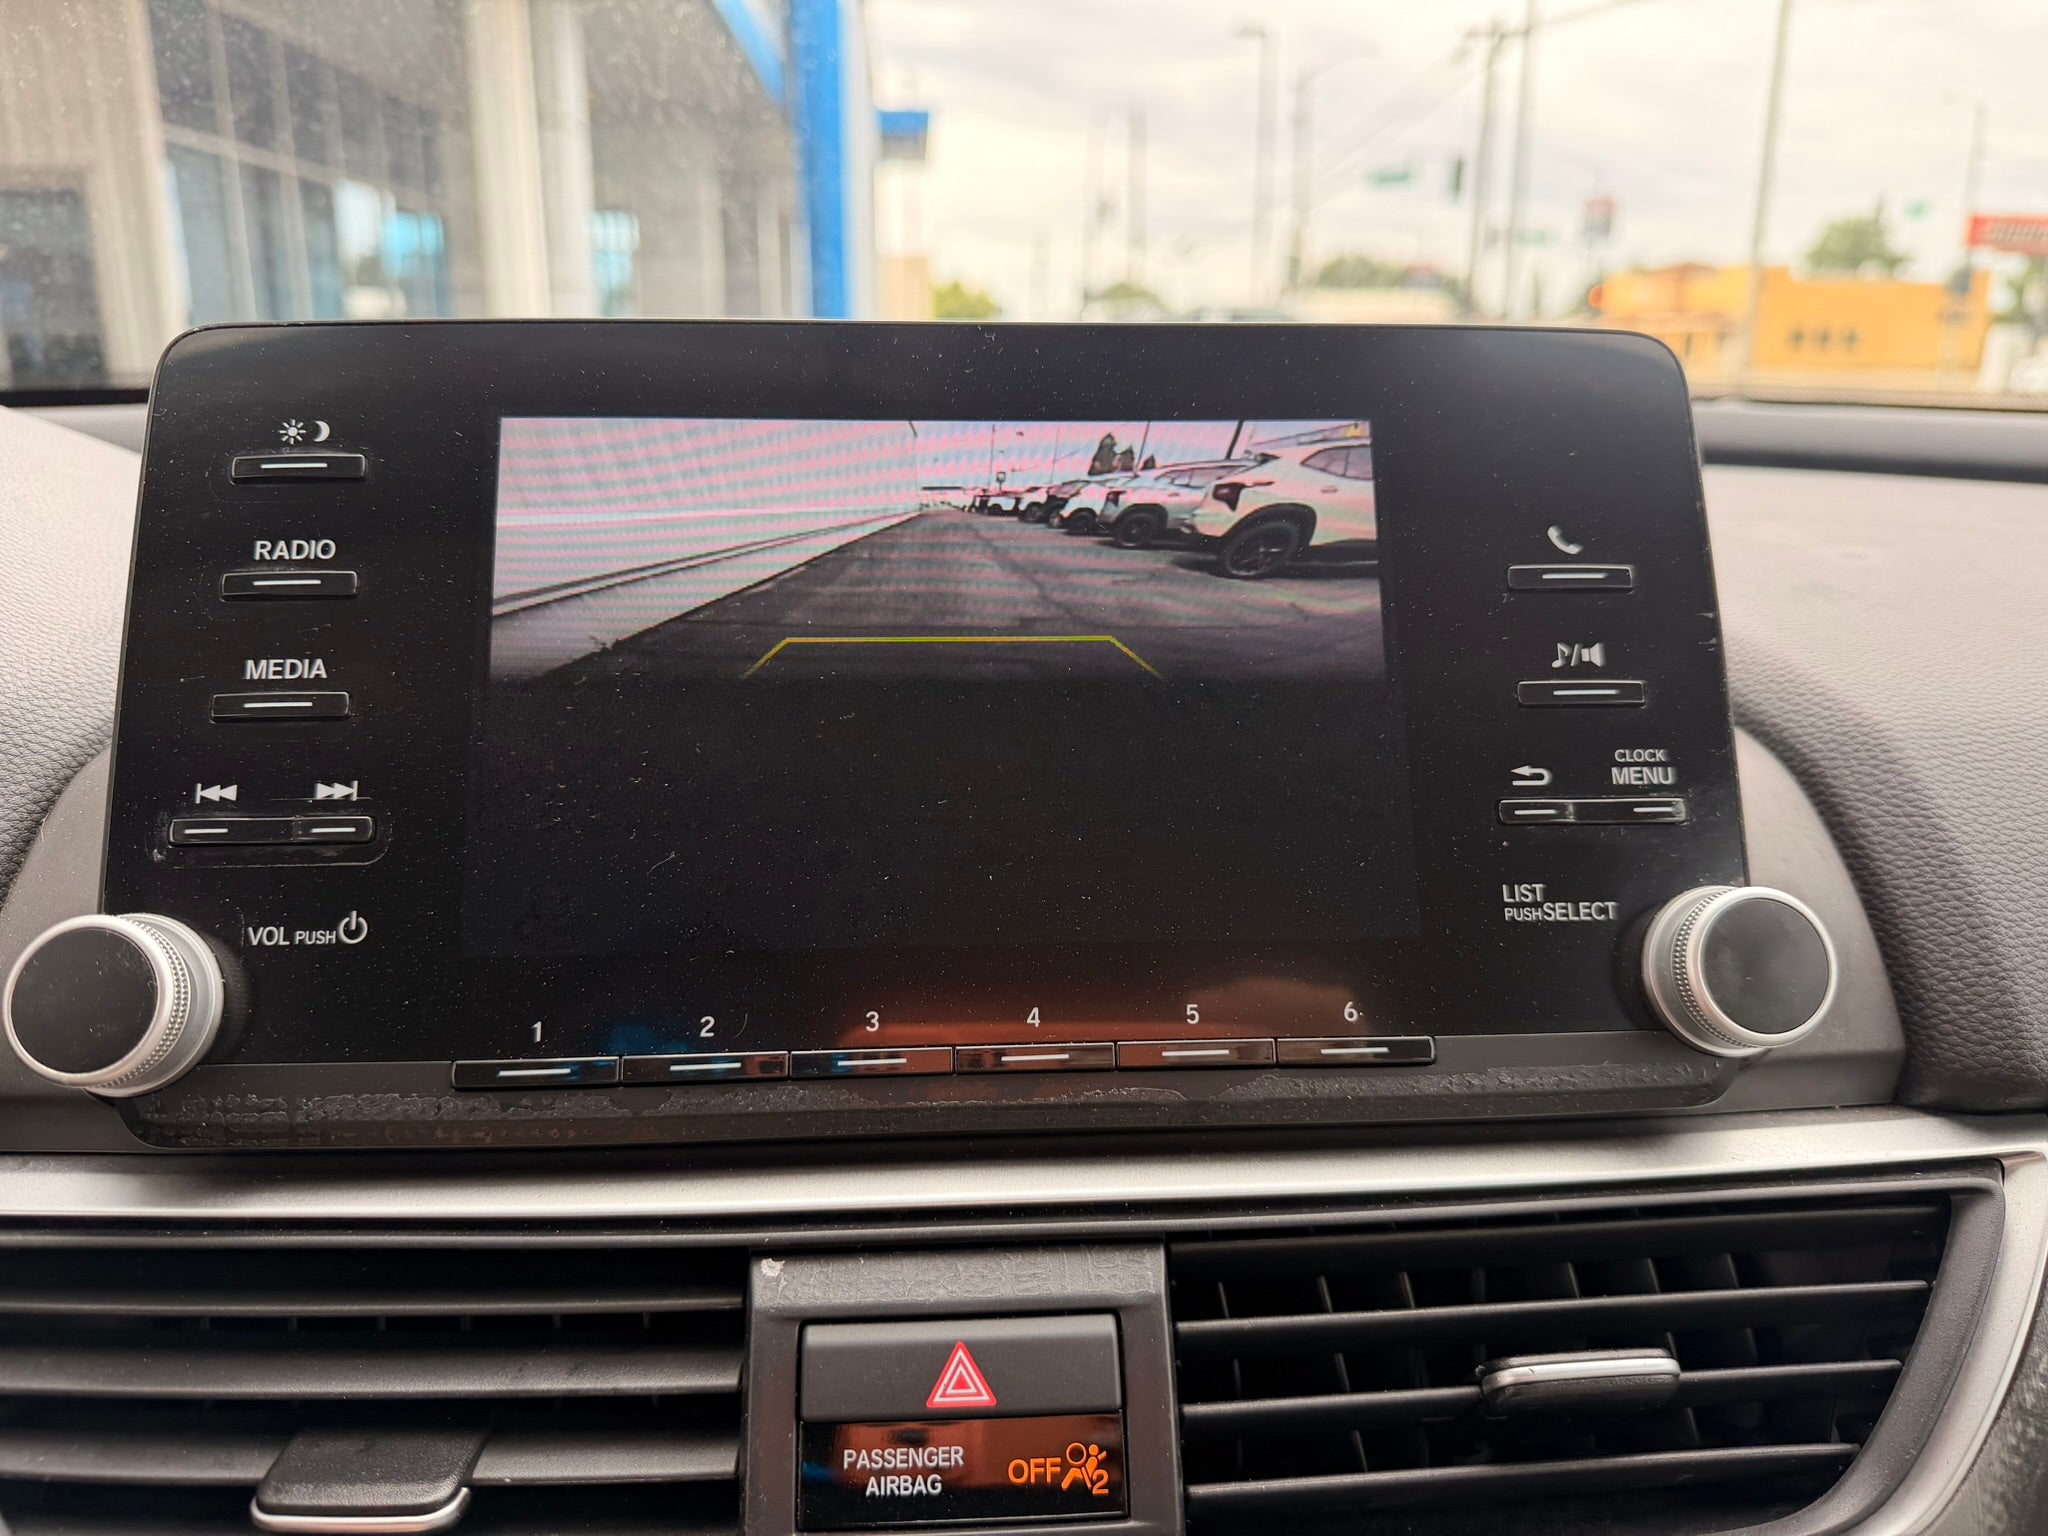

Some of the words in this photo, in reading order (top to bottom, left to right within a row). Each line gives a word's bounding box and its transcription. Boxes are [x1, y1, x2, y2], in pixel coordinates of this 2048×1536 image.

[254, 539, 337, 560] RADIO
[245, 658, 328, 680] MEDIA
[1614, 749, 1667, 762] CLOCK
[1611, 766, 1676, 785] MENU
[1502, 883, 1546, 902] LIST
[1504, 907, 1543, 921] PUSH
[1543, 901, 1618, 921] SELECT
[248, 926, 290, 946] VOL
[295, 928, 336, 944] PUSH
[865, 1010, 880, 1032] 3
[1026, 1006, 1041, 1028] 4
[1186, 1003, 1200, 1025] 5
[1343, 1001, 1359, 1023] 6
[532, 1020, 544, 1043] 1
[699, 1015, 715, 1037] 2
[843, 1445, 965, 1471] PASSENGER
[1008, 1457, 1062, 1484] OFF
[865, 1473, 943, 1498] AIRBAG
